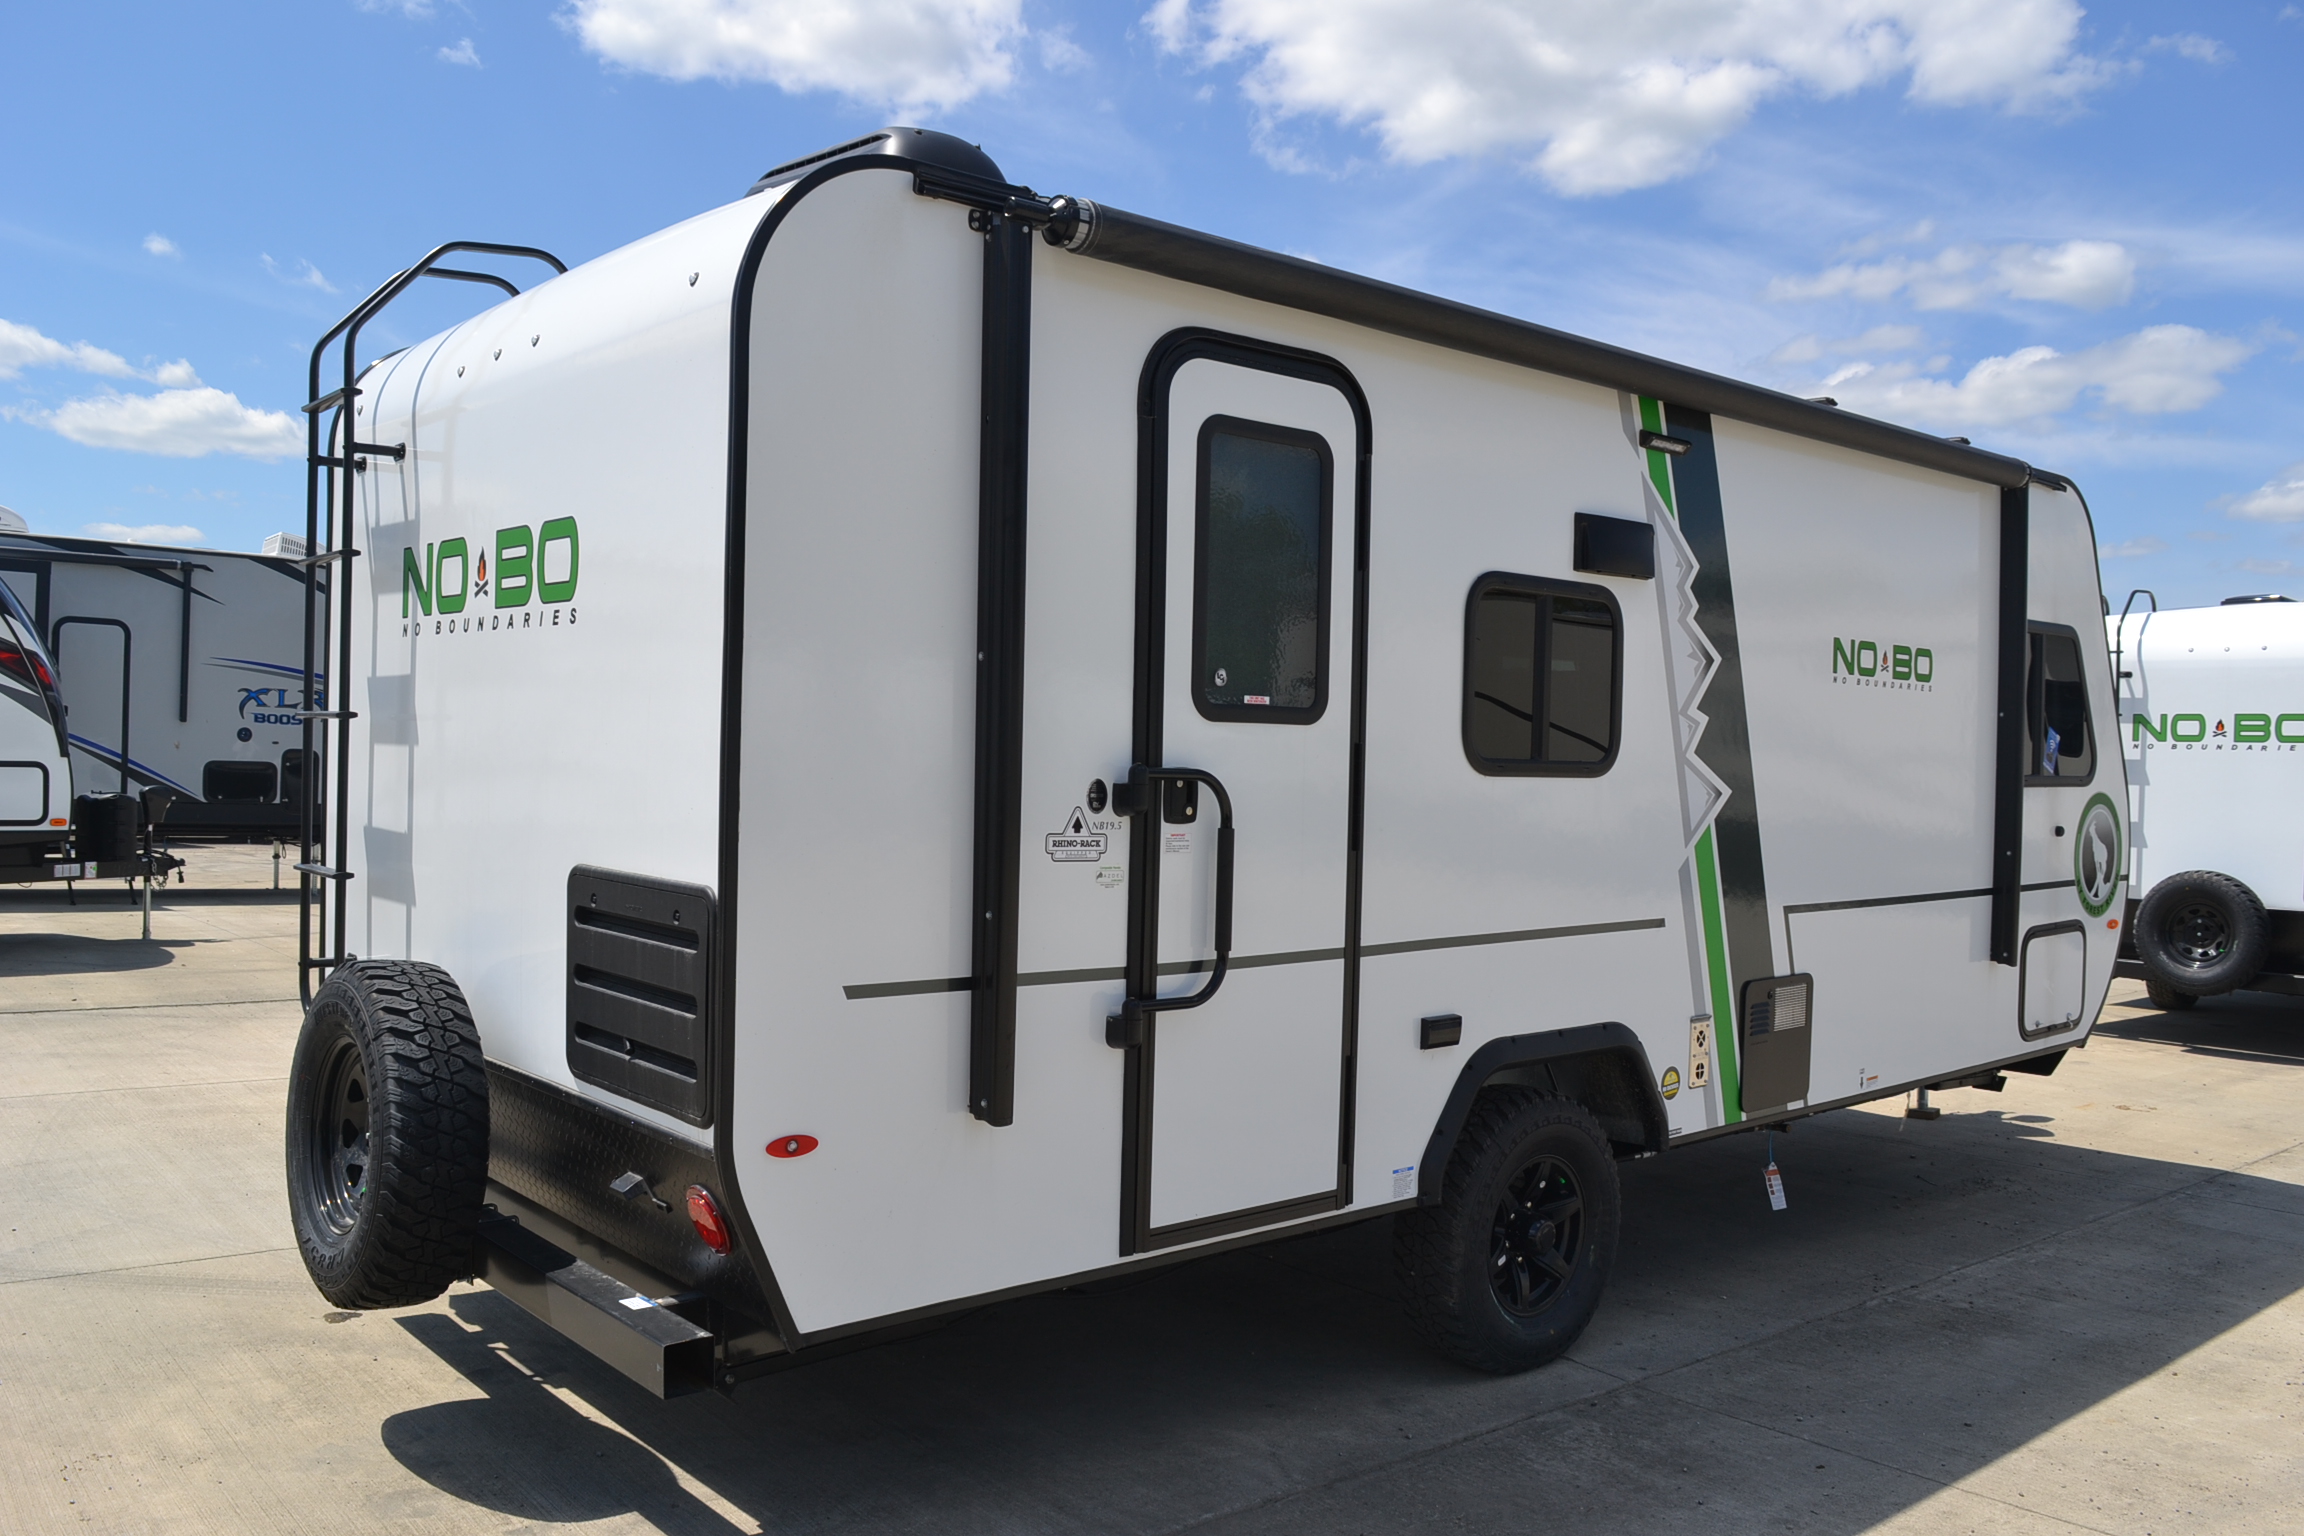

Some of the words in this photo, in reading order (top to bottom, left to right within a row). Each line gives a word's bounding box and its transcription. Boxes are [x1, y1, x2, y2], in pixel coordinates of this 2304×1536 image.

[402, 623, 421, 638] NO
[435, 607, 577, 635] BOUNDARIES
[1832, 676, 1847, 685] NO
[1856, 678, 1932, 693] BOUNDARIES
[252, 712, 304, 726] BOOS
[2132, 743, 2155, 751] NO
[2170, 744, 2297, 752] BOUNDARIE
[1091, 821, 1123, 831] NB19.5
[1051, 839, 1102, 848] RHINO-RACK
[2082, 896, 2104, 915] FOREST
